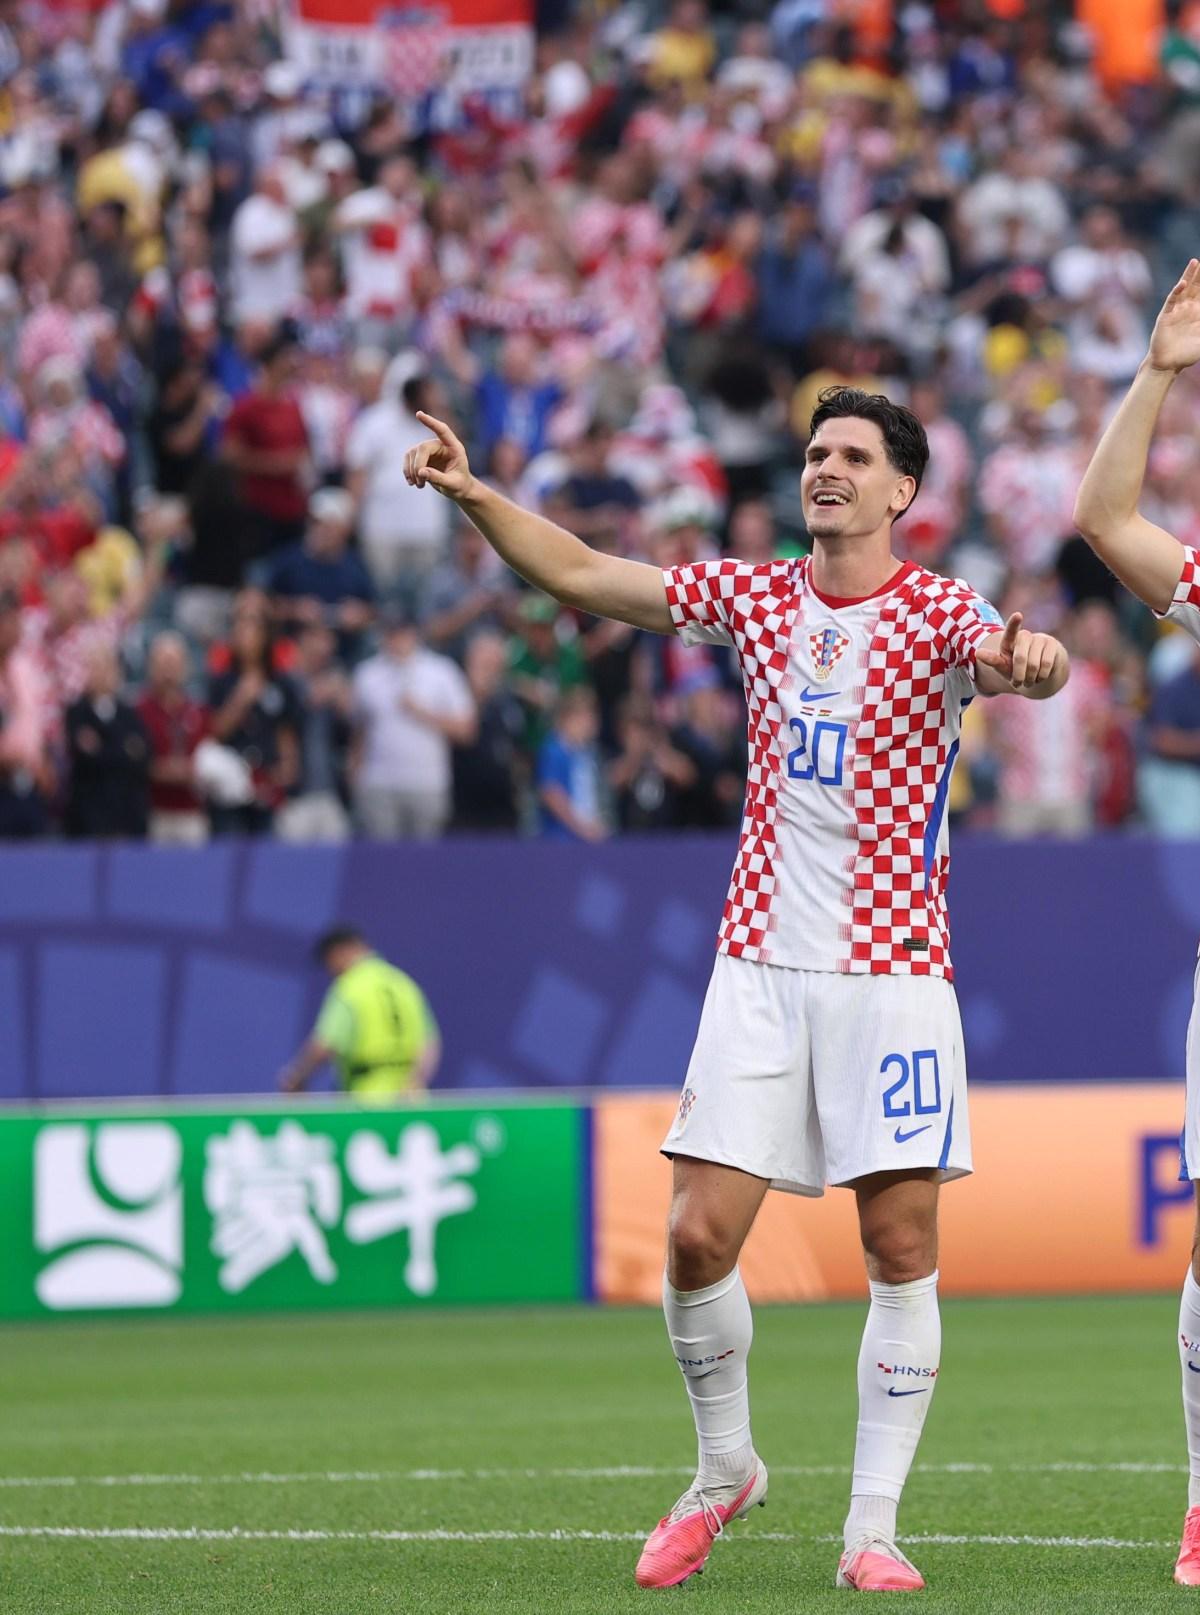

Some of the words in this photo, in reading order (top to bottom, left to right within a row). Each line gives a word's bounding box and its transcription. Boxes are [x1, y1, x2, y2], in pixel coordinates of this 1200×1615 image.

[787, 717, 849, 786] 20
[879, 1049, 942, 1119] 20
[202, 1119, 478, 1295] 蒙牛
[893, 1365, 931, 1377] HNS
